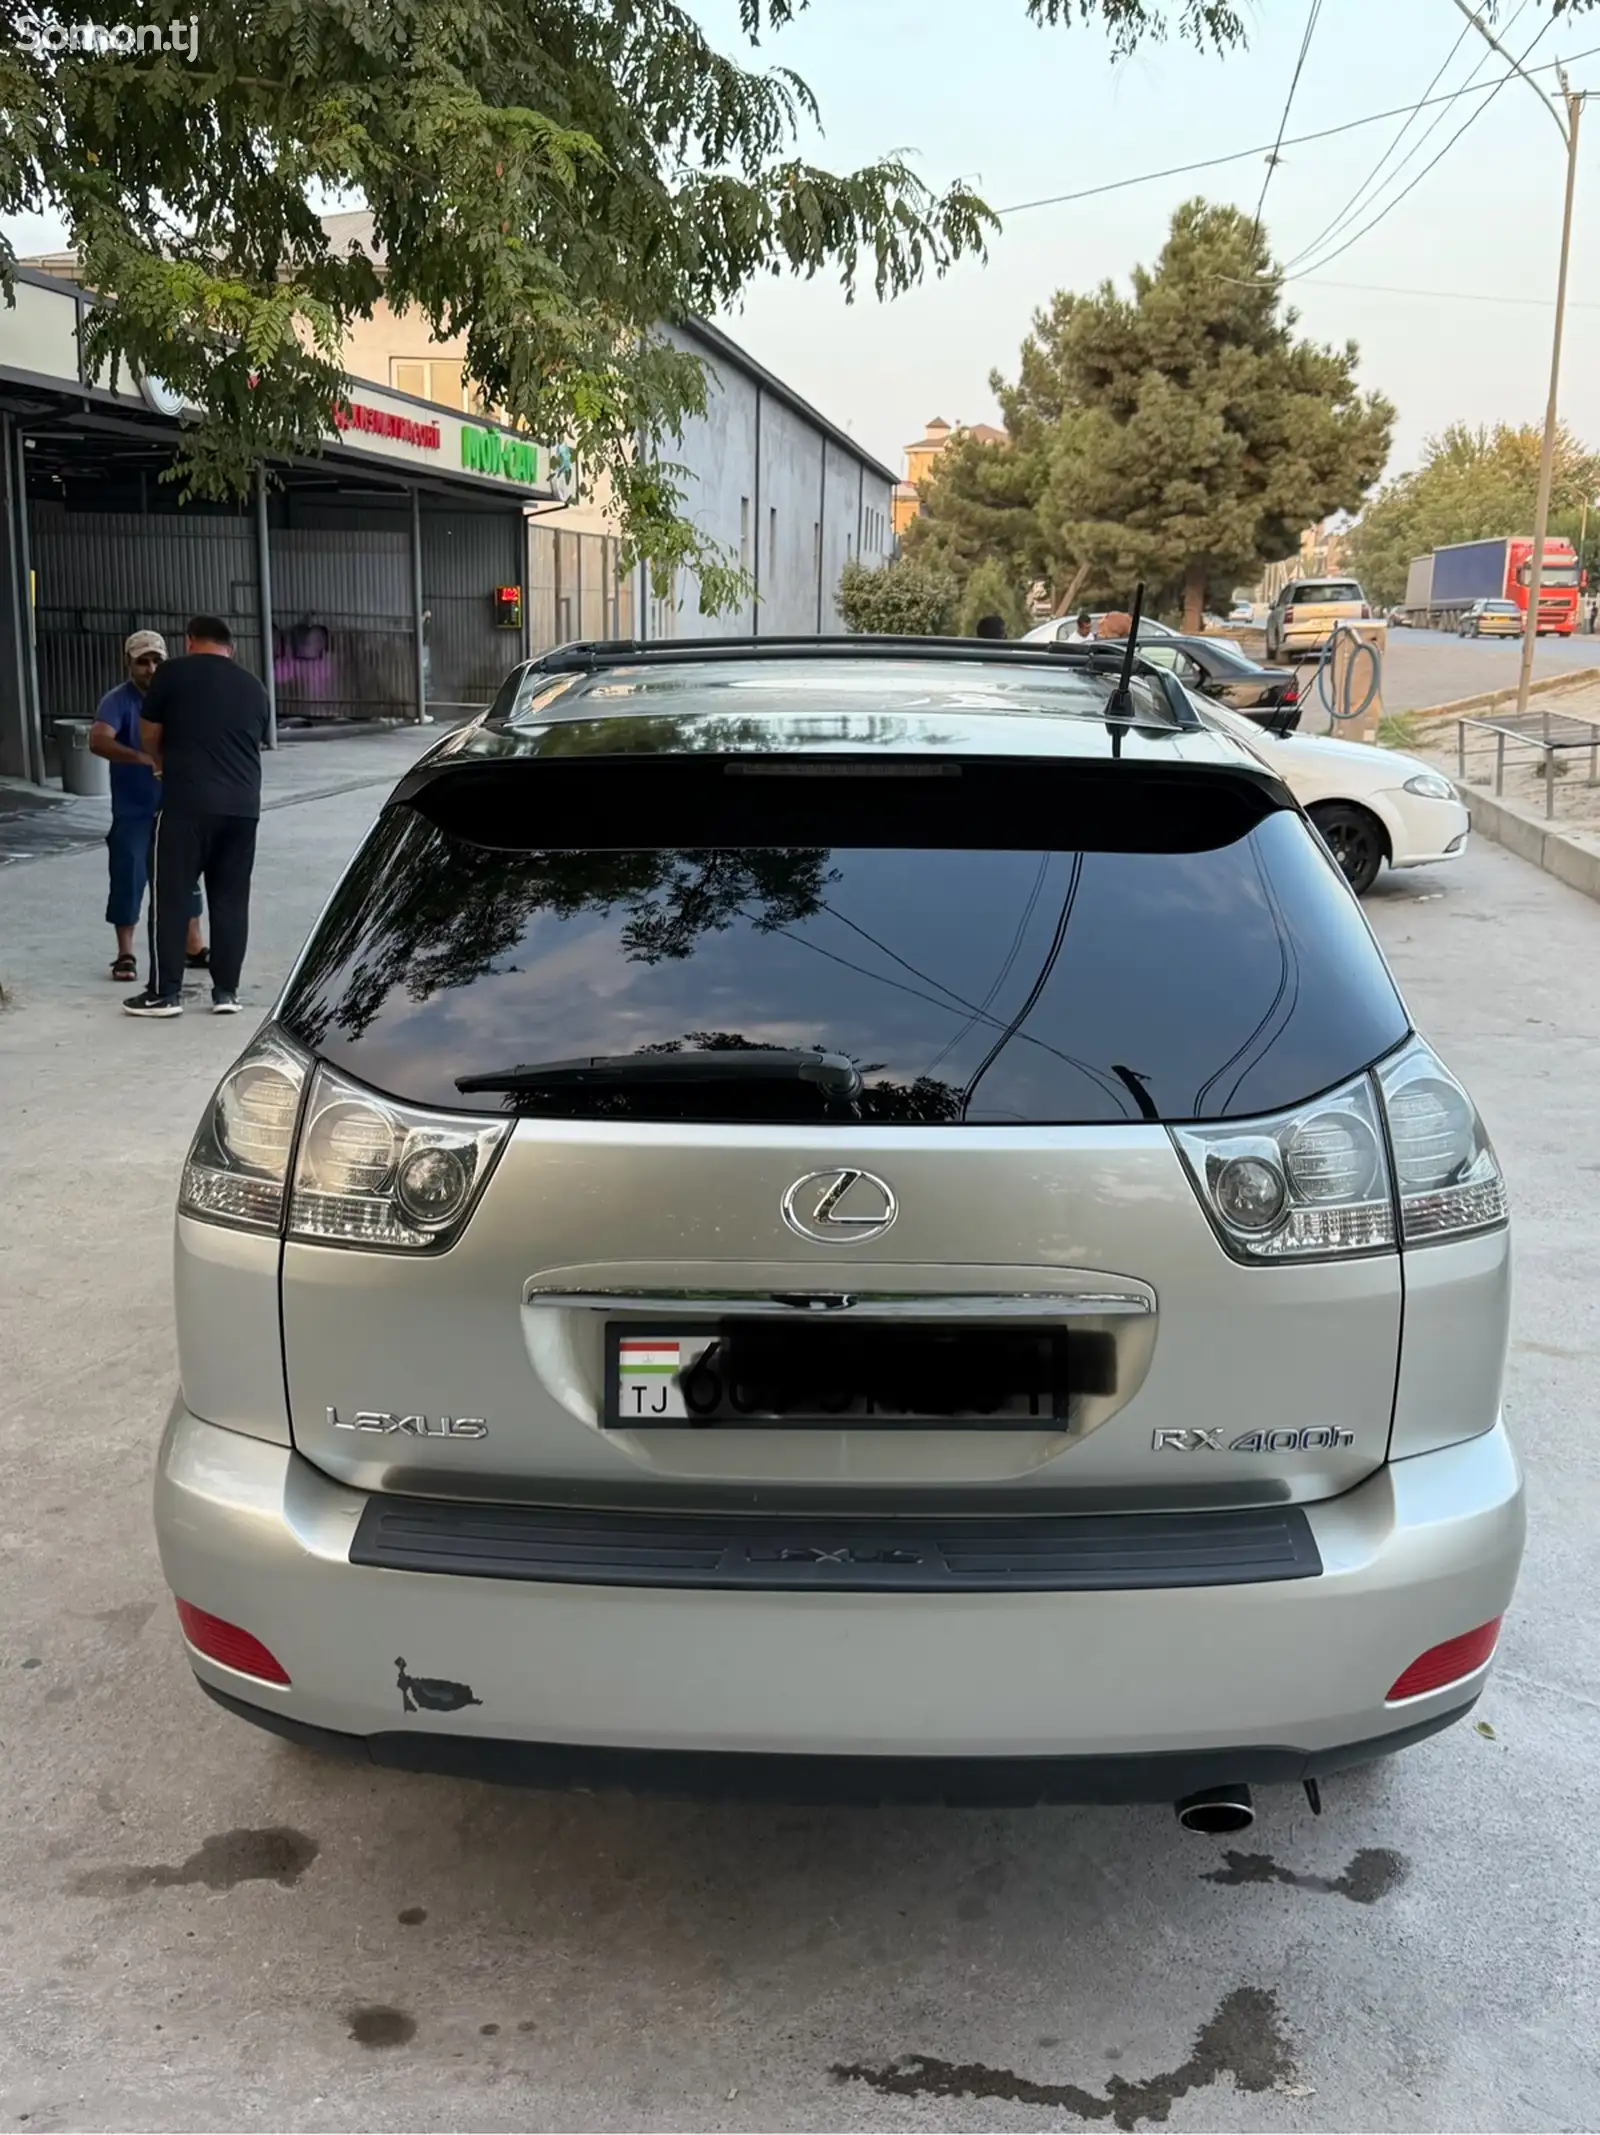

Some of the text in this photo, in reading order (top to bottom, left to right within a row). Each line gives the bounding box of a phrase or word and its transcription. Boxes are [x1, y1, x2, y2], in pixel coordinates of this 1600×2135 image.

[631, 1386, 669, 1414] TJ
[326, 1406, 489, 1440] LEXUS
[1152, 1425, 1356, 1453] RX 400h
